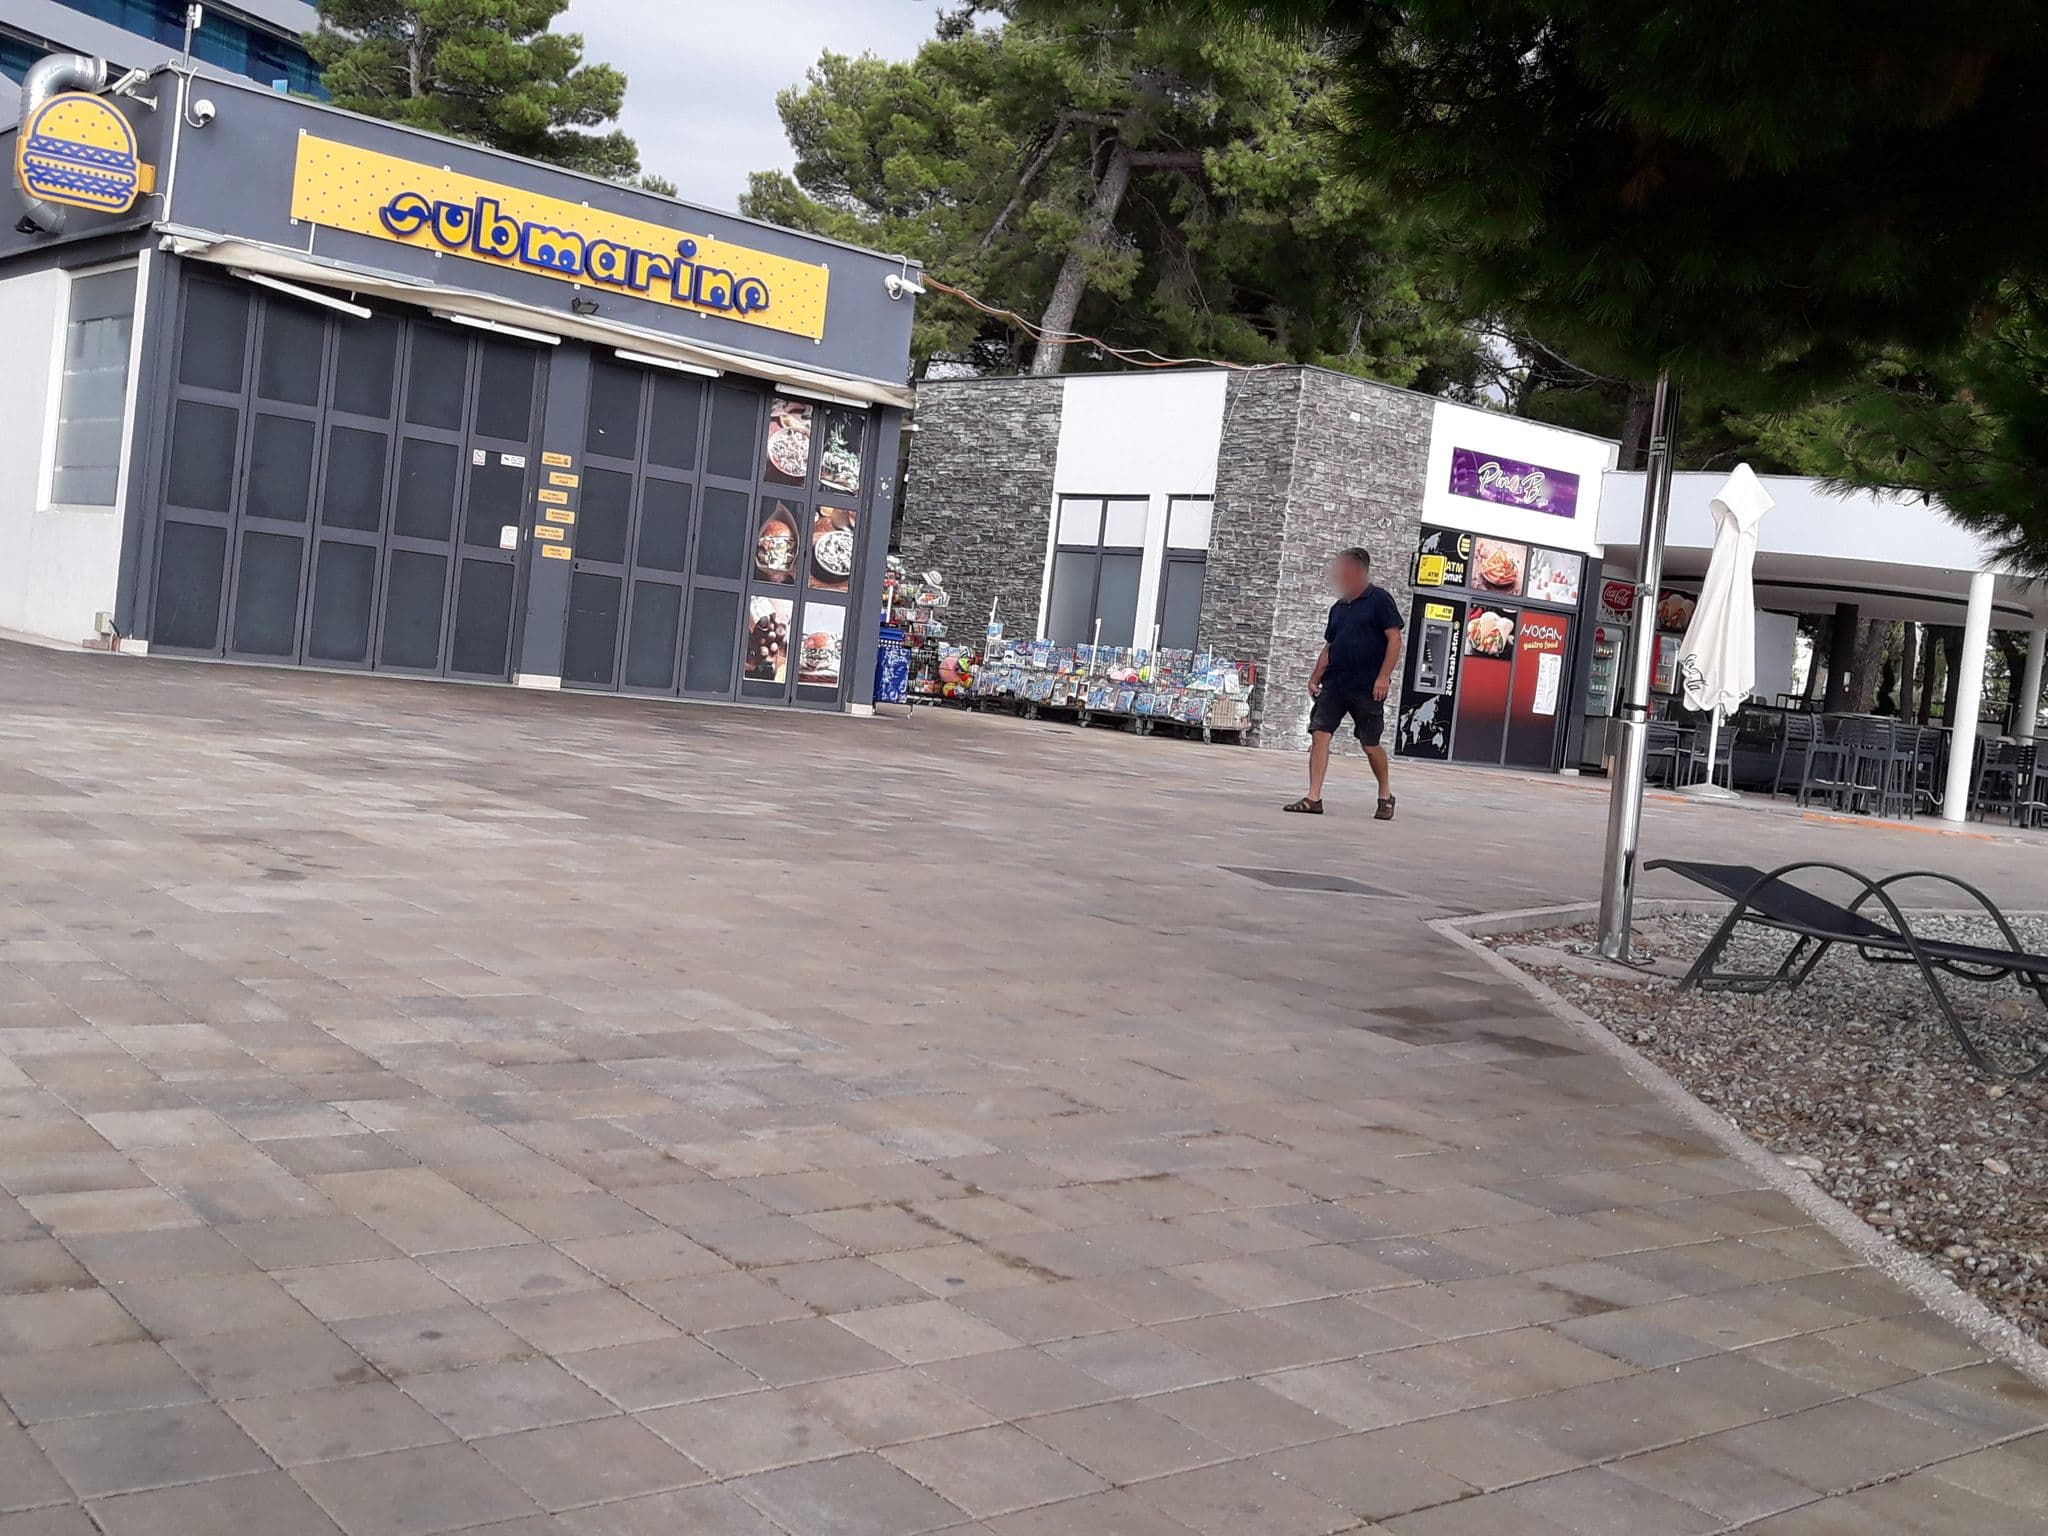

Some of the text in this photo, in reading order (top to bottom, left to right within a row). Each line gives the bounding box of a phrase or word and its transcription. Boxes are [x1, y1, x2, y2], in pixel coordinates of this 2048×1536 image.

[1446, 561, 1464, 573] ATM
[1523, 640, 1559, 651] gastro food
